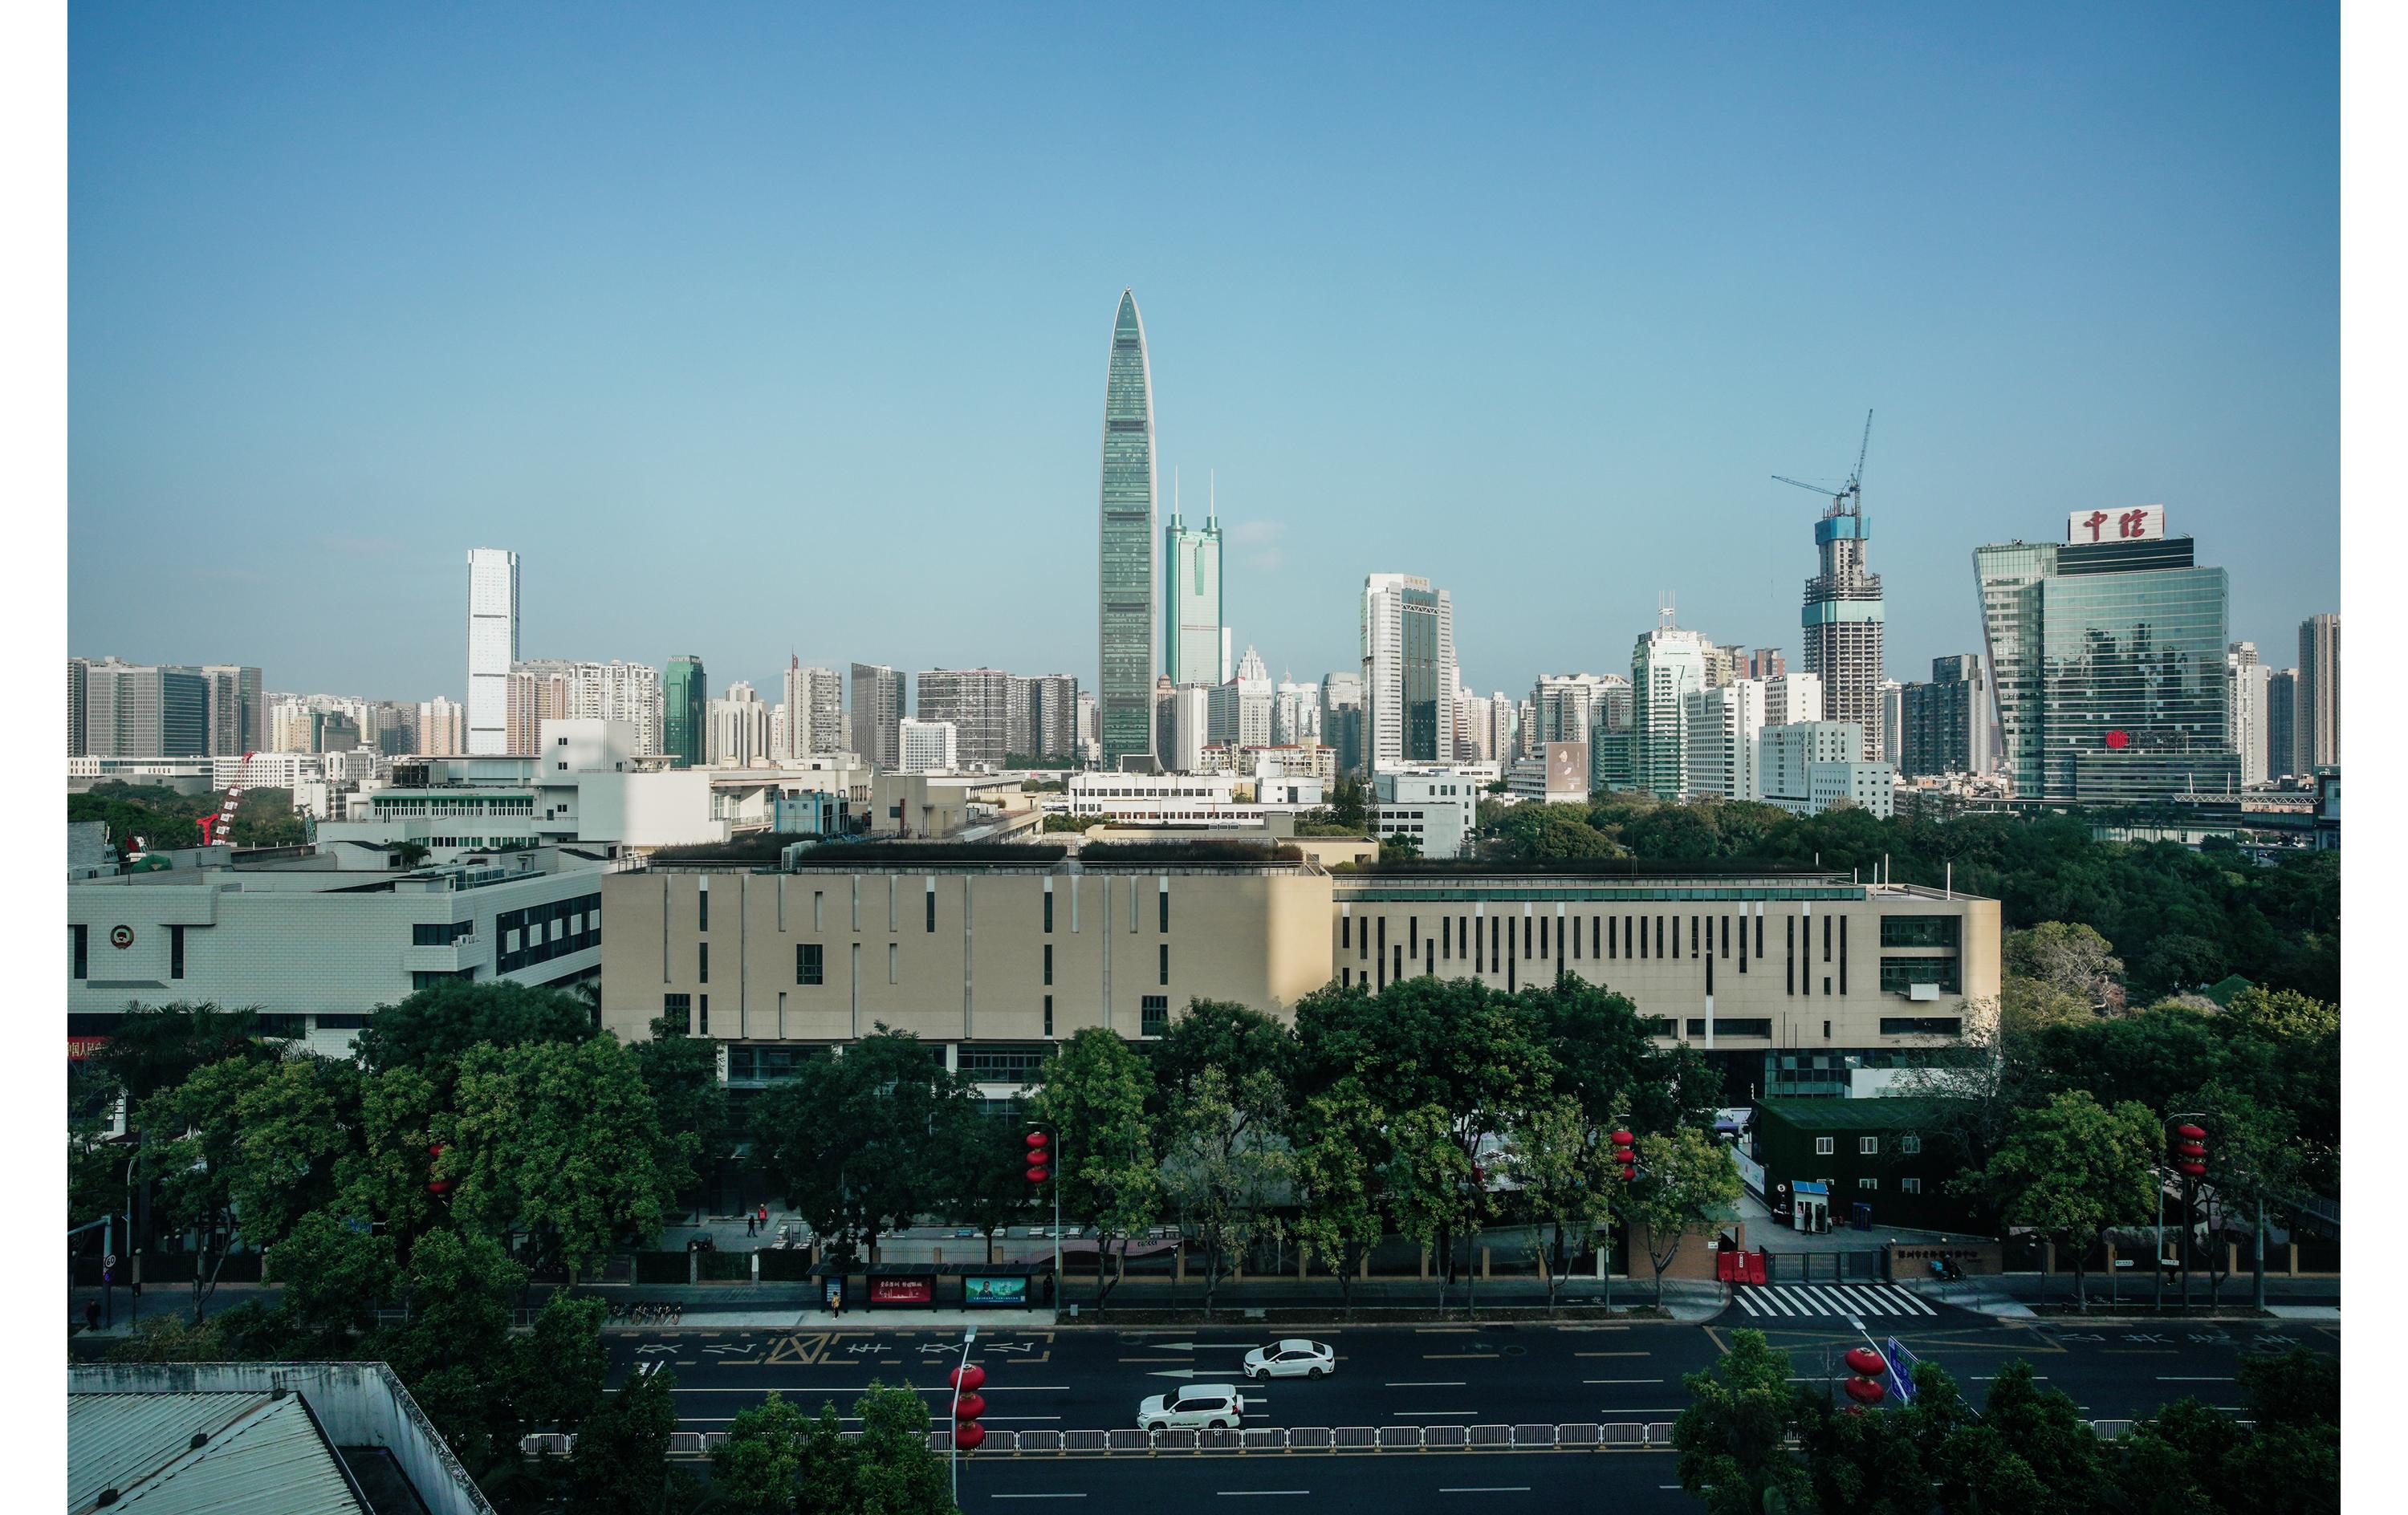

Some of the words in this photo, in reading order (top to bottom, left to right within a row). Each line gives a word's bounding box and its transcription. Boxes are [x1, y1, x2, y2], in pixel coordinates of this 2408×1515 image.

[2083, 509, 2148, 542] 中信
[107, 1257, 115, 1265] 60
[606, 1343, 758, 1354] 公交
